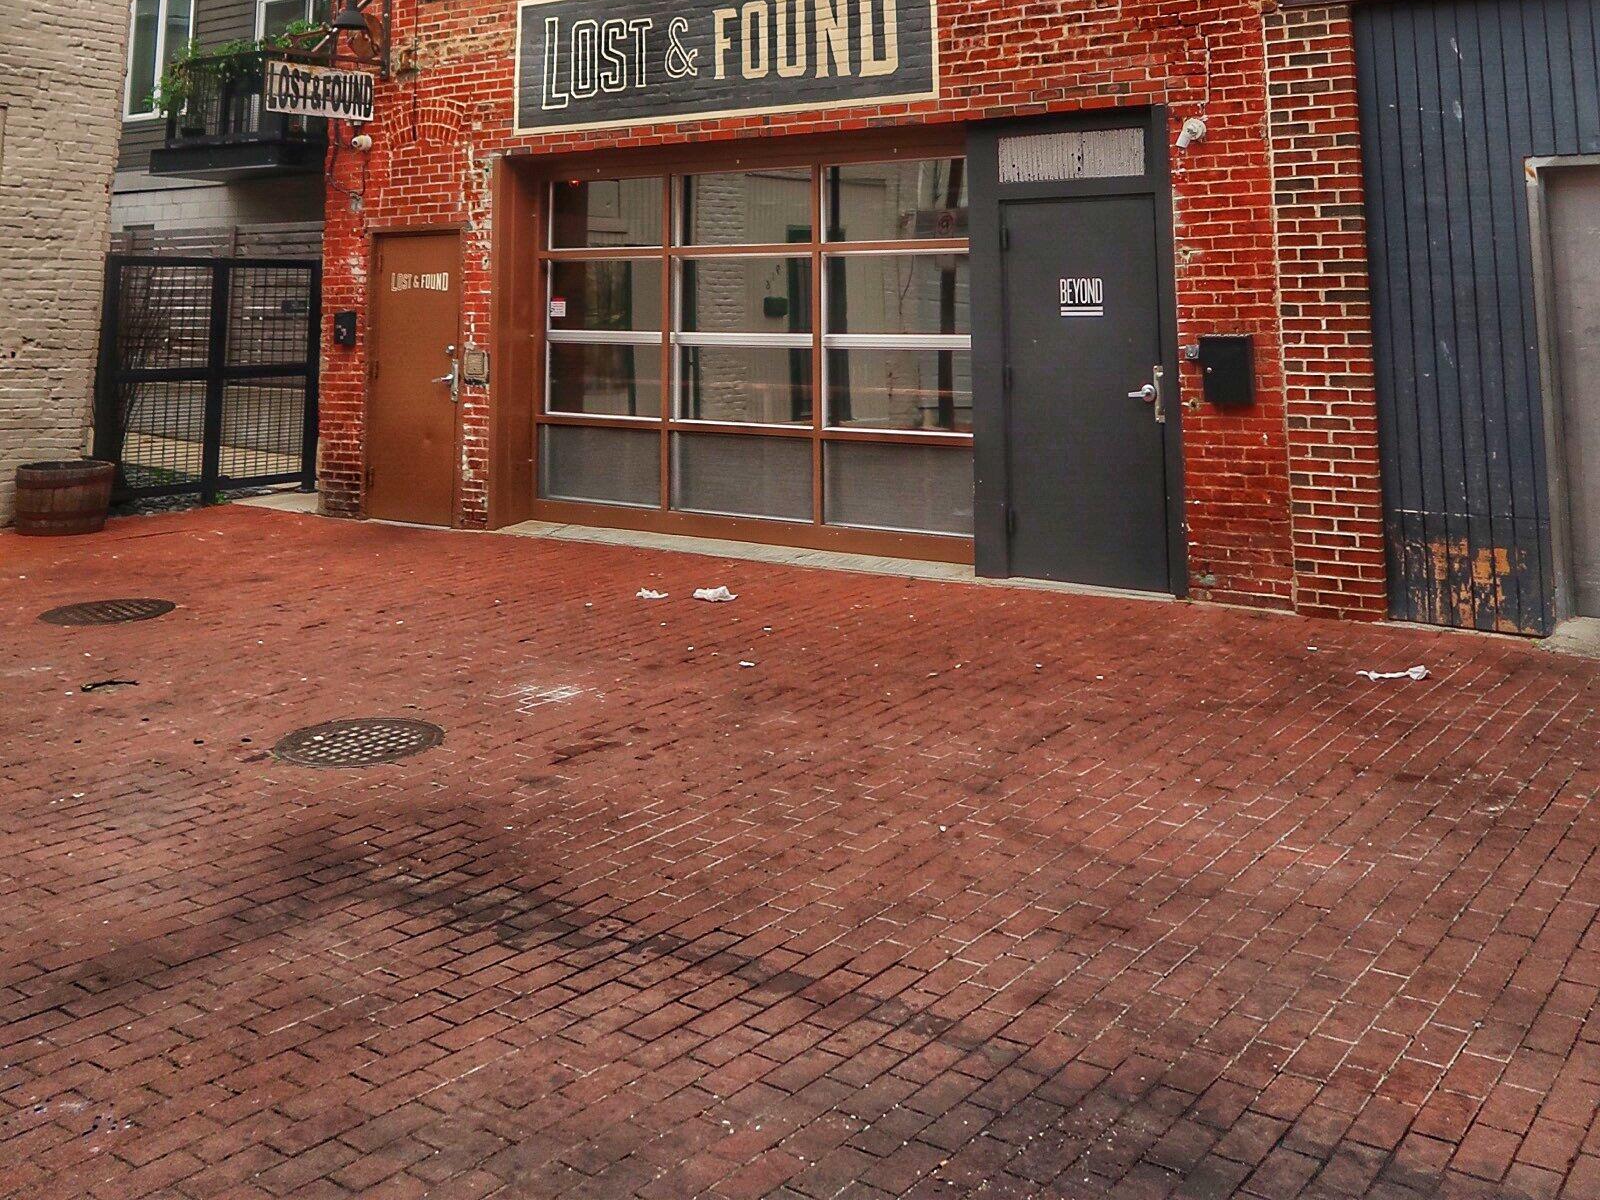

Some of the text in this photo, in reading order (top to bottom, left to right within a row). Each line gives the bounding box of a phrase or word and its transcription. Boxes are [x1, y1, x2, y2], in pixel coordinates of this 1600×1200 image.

[541, 17, 653, 110] LOST
[664, 16, 698, 79] &
[391, 272, 449, 291] LOST & FOUND
[1060, 278, 1103, 304] BEYOND
